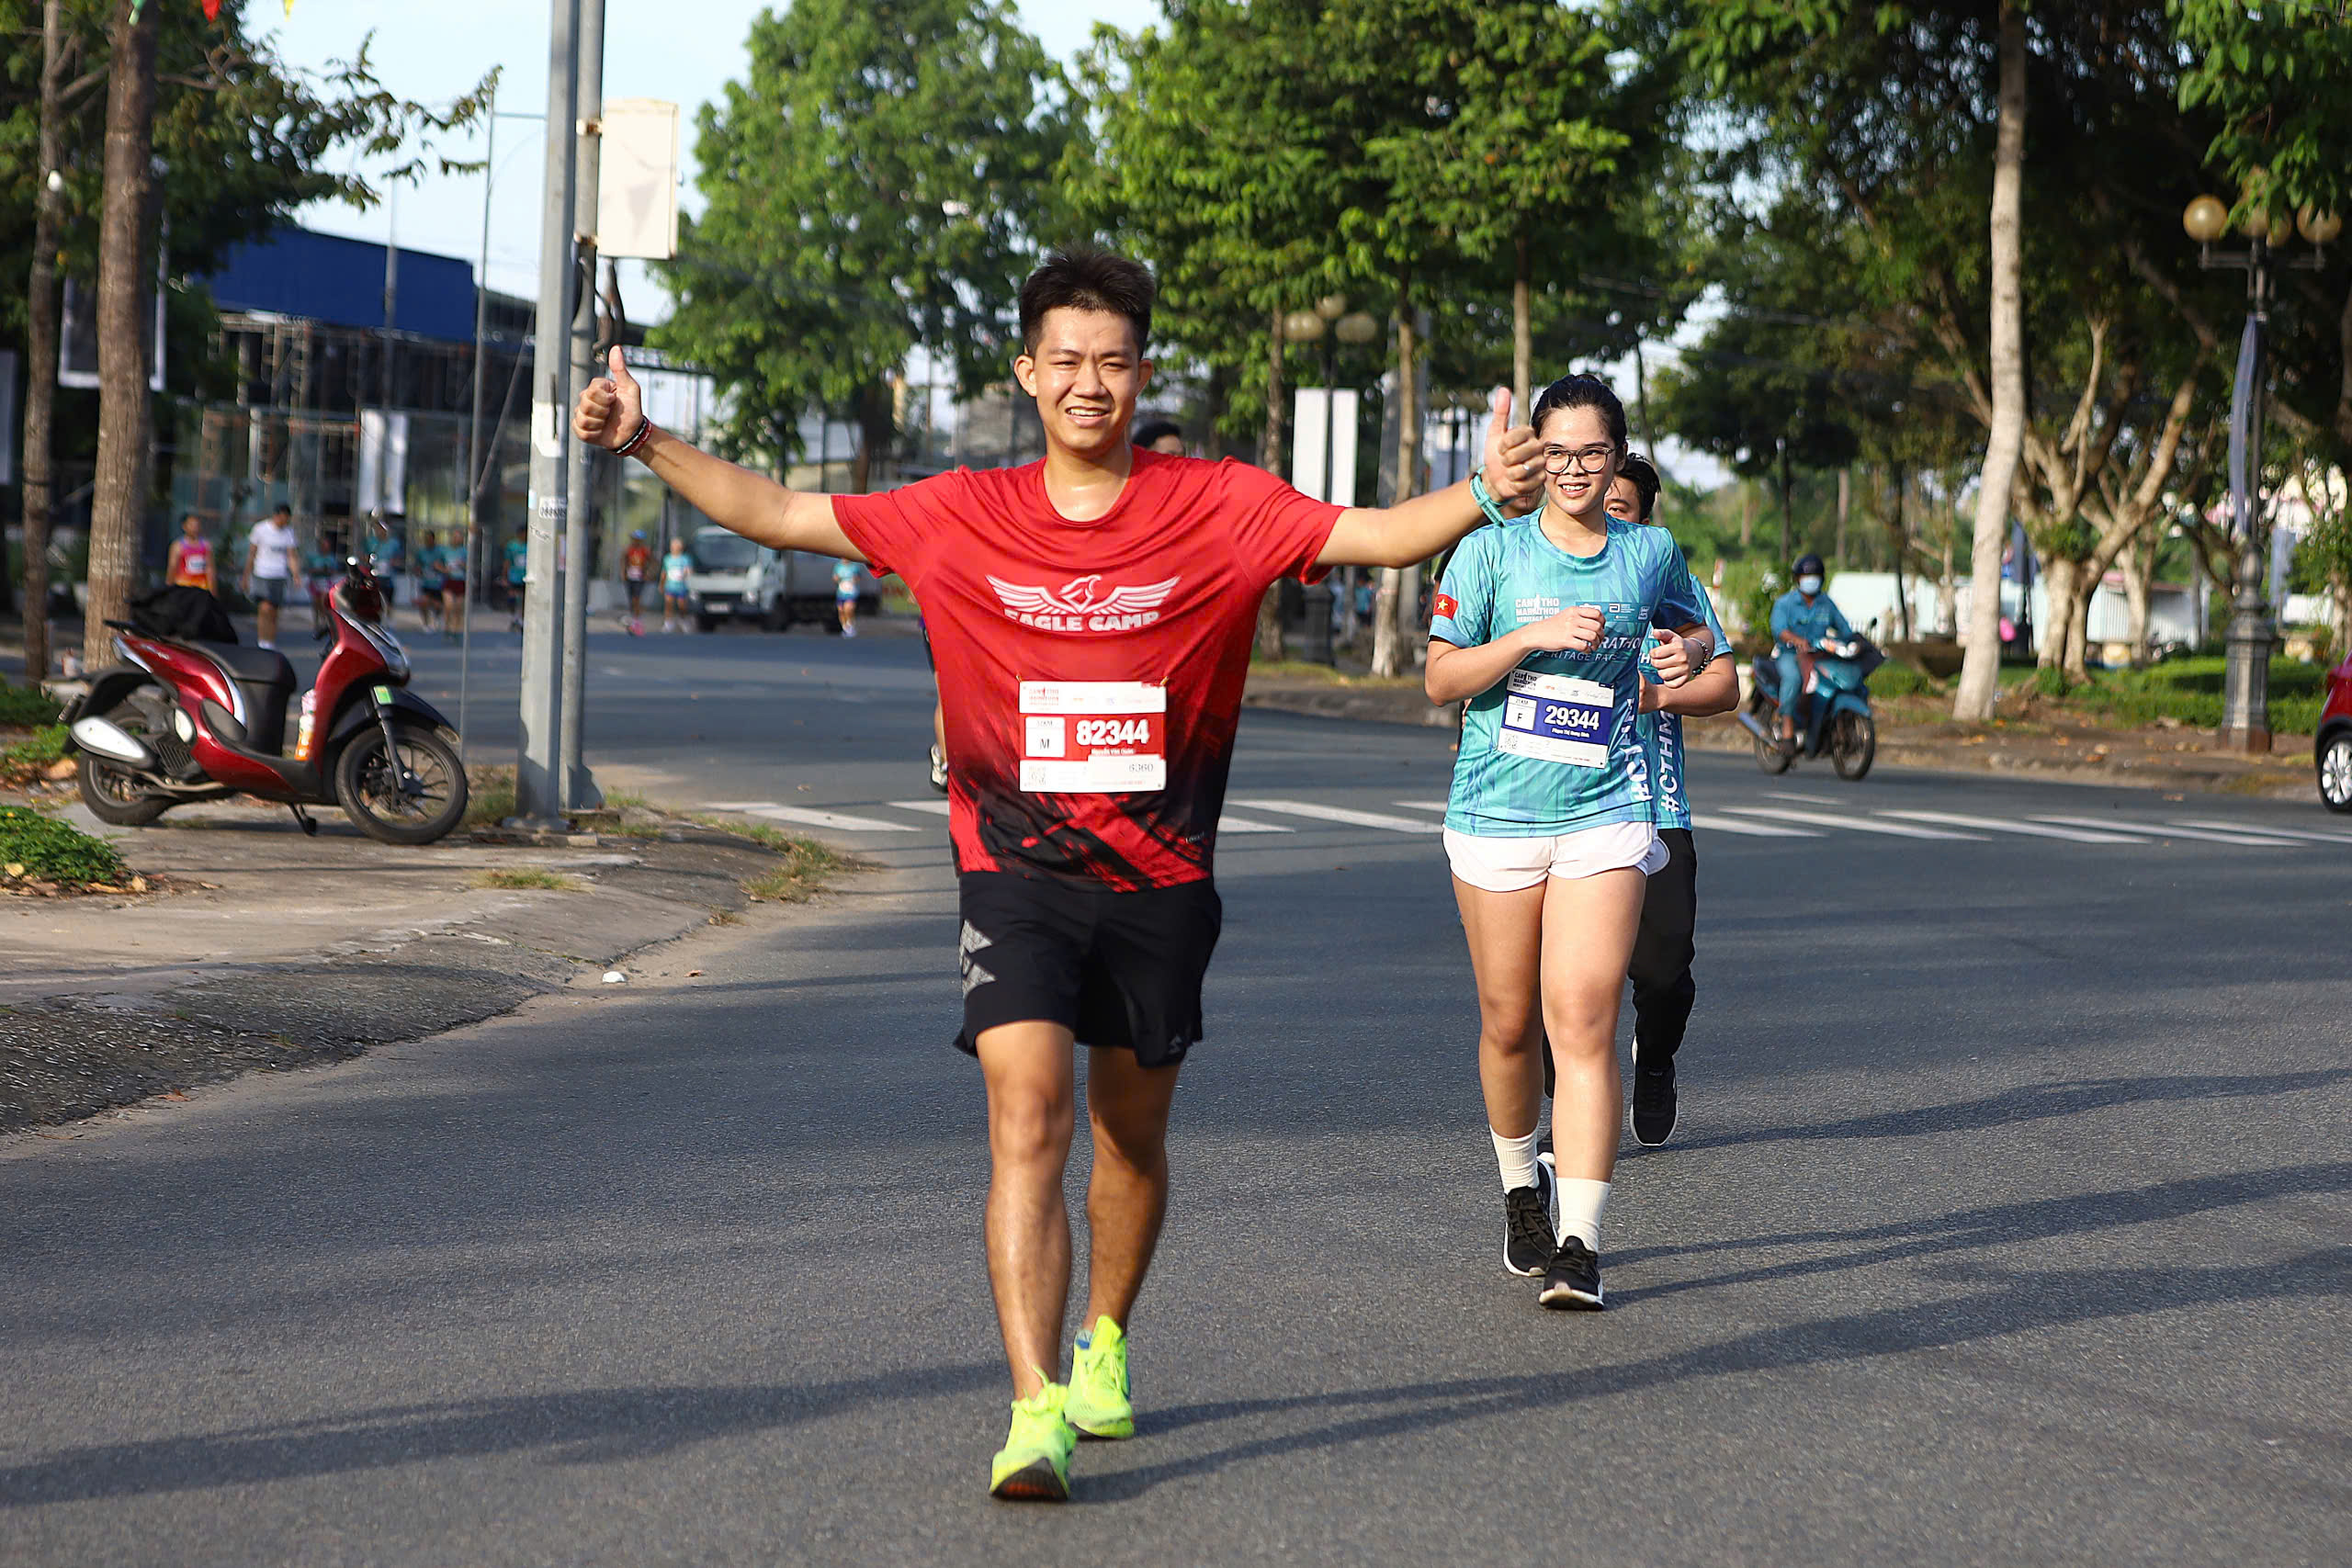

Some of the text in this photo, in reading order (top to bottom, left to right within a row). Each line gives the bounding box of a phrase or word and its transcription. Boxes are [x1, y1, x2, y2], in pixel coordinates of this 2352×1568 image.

[1541, 597, 1560, 607] THO
[1003, 607, 1159, 632] EAGLE CAMP
[1517, 712, 1523, 722] F
[1544, 705, 1600, 731] 29344
[1076, 718, 1150, 746] 82344
[1039, 738, 1050, 750] M
